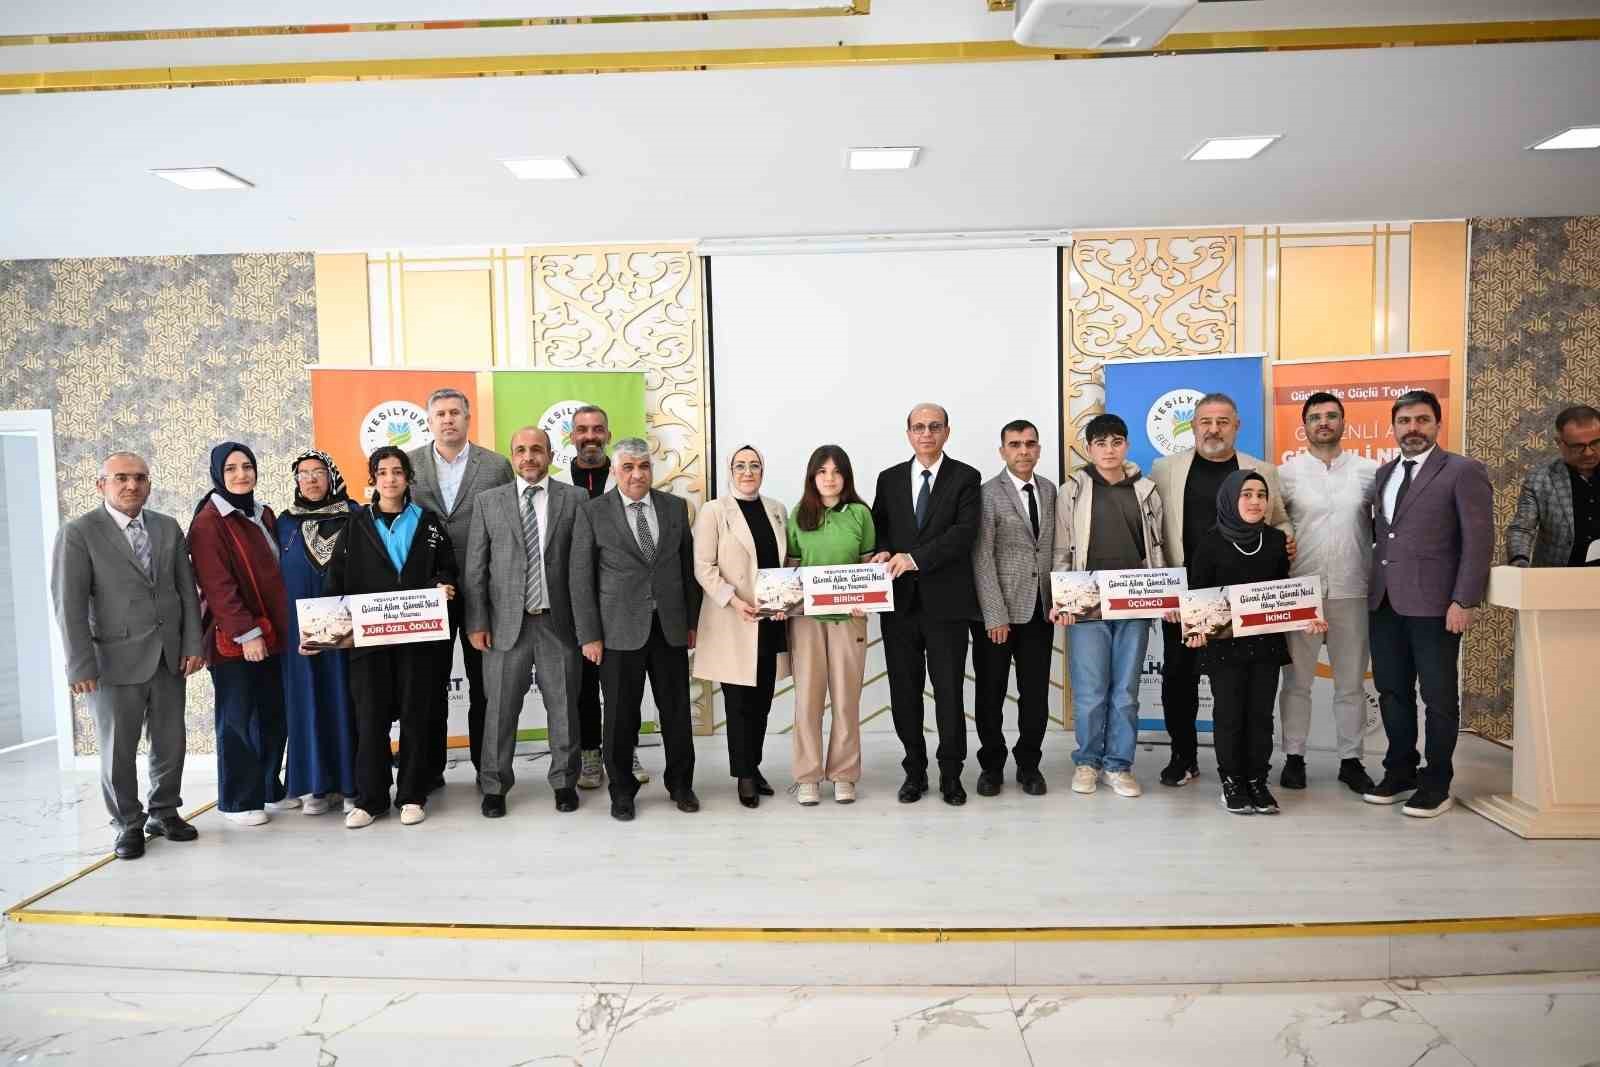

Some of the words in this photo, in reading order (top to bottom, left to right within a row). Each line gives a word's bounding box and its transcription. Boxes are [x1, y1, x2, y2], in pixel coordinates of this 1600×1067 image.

[1348, 387, 1378, 400] Güçlü
[833, 593, 864, 603] BİRİNCİ
[1128, 599, 1162, 608] ÜÇÜNCÜ
[1265, 611, 1291, 622] İKİNCİ
[366, 625, 384, 634] JÜRİ
[386, 624, 408, 633] ÖZEL
[409, 621, 438, 630] ÖDÜLÜ
